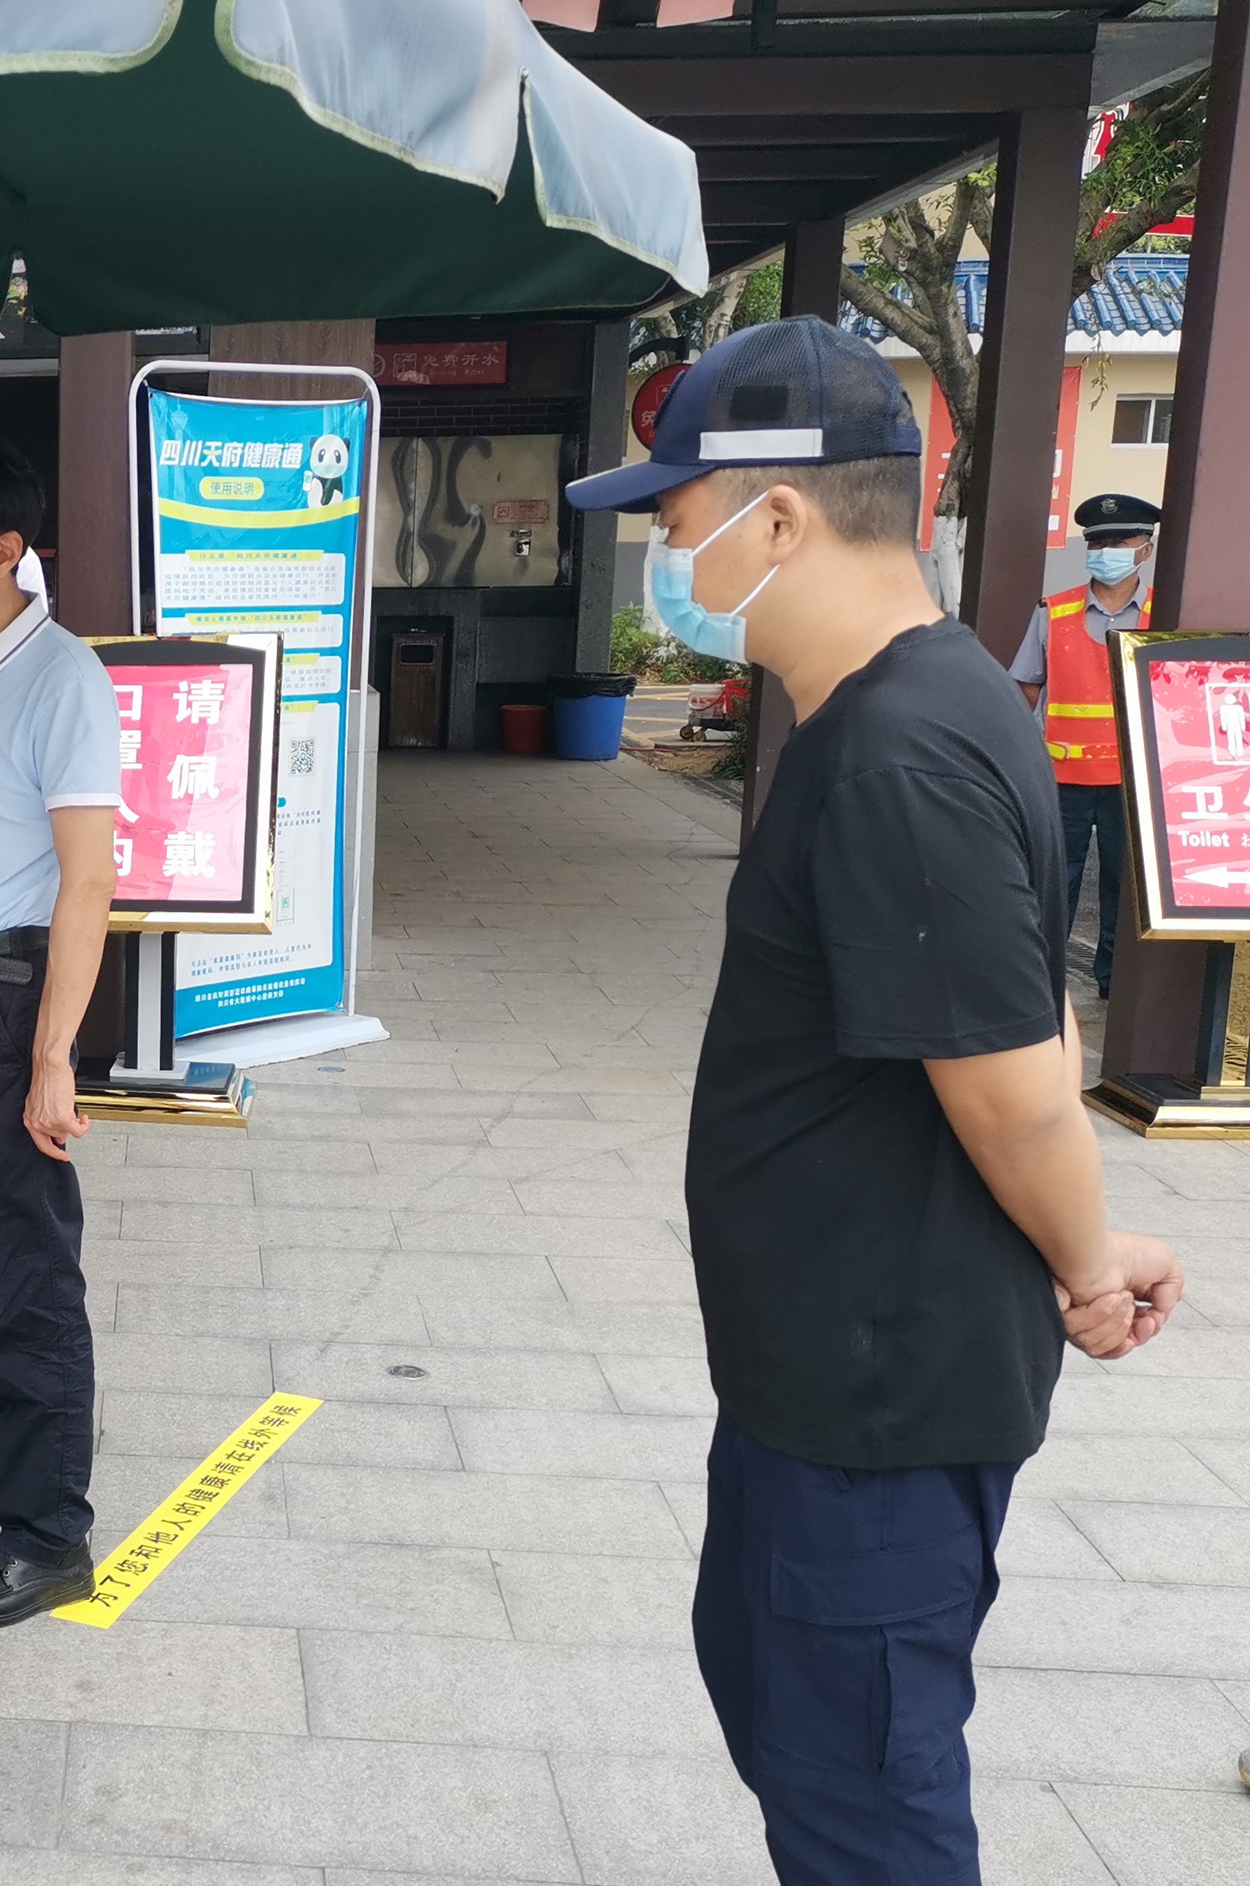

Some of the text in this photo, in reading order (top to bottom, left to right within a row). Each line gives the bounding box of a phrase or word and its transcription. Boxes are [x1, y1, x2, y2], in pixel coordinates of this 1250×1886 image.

[422, 353, 500, 367] 免费开水
[159, 438, 304, 471] 四川天府健康通
[209, 480, 255, 497] 使用说明
[163, 680, 225, 878] 请佩戴
[1177, 830, 1231, 848] Toilet
